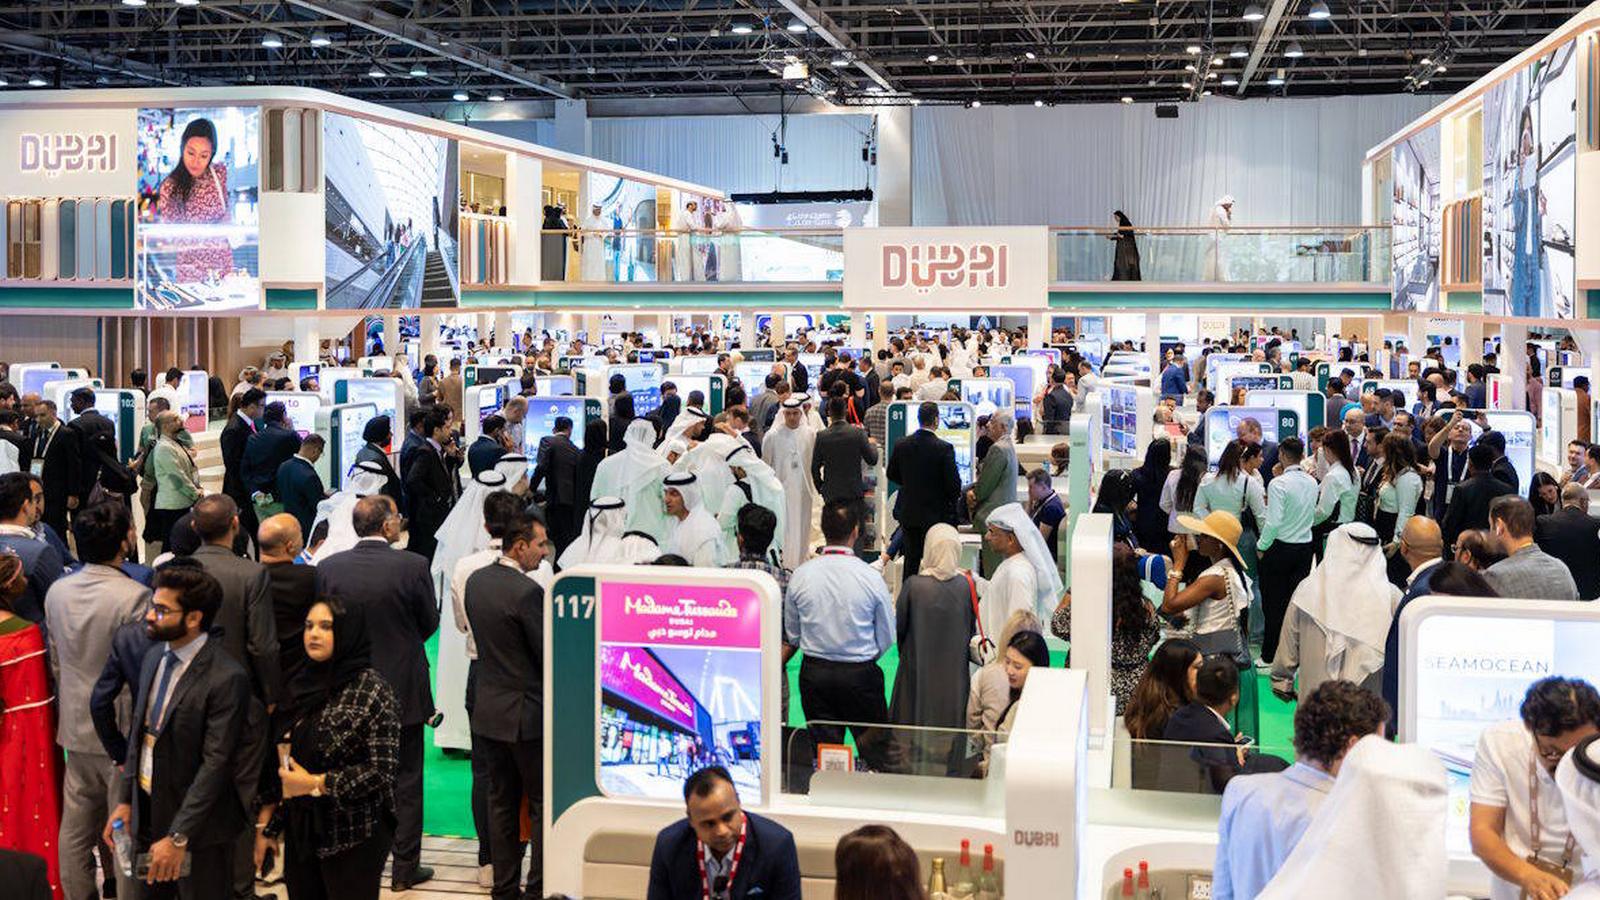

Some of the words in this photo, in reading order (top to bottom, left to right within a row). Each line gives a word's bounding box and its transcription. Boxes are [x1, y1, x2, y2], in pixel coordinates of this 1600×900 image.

[21, 134, 116, 175] DUBAI
[882, 245, 1008, 292] DUBAI
[121, 398, 136, 408] 102
[892, 410, 904, 421] 81
[1281, 416, 1295, 428] 80
[554, 594, 596, 619] 117
[624, 595, 681, 616] Madame
[677, 598, 739, 618] Tussauds
[1425, 656, 1550, 674] SEAMOCEAN
[1014, 829, 1060, 849] DUBAI
